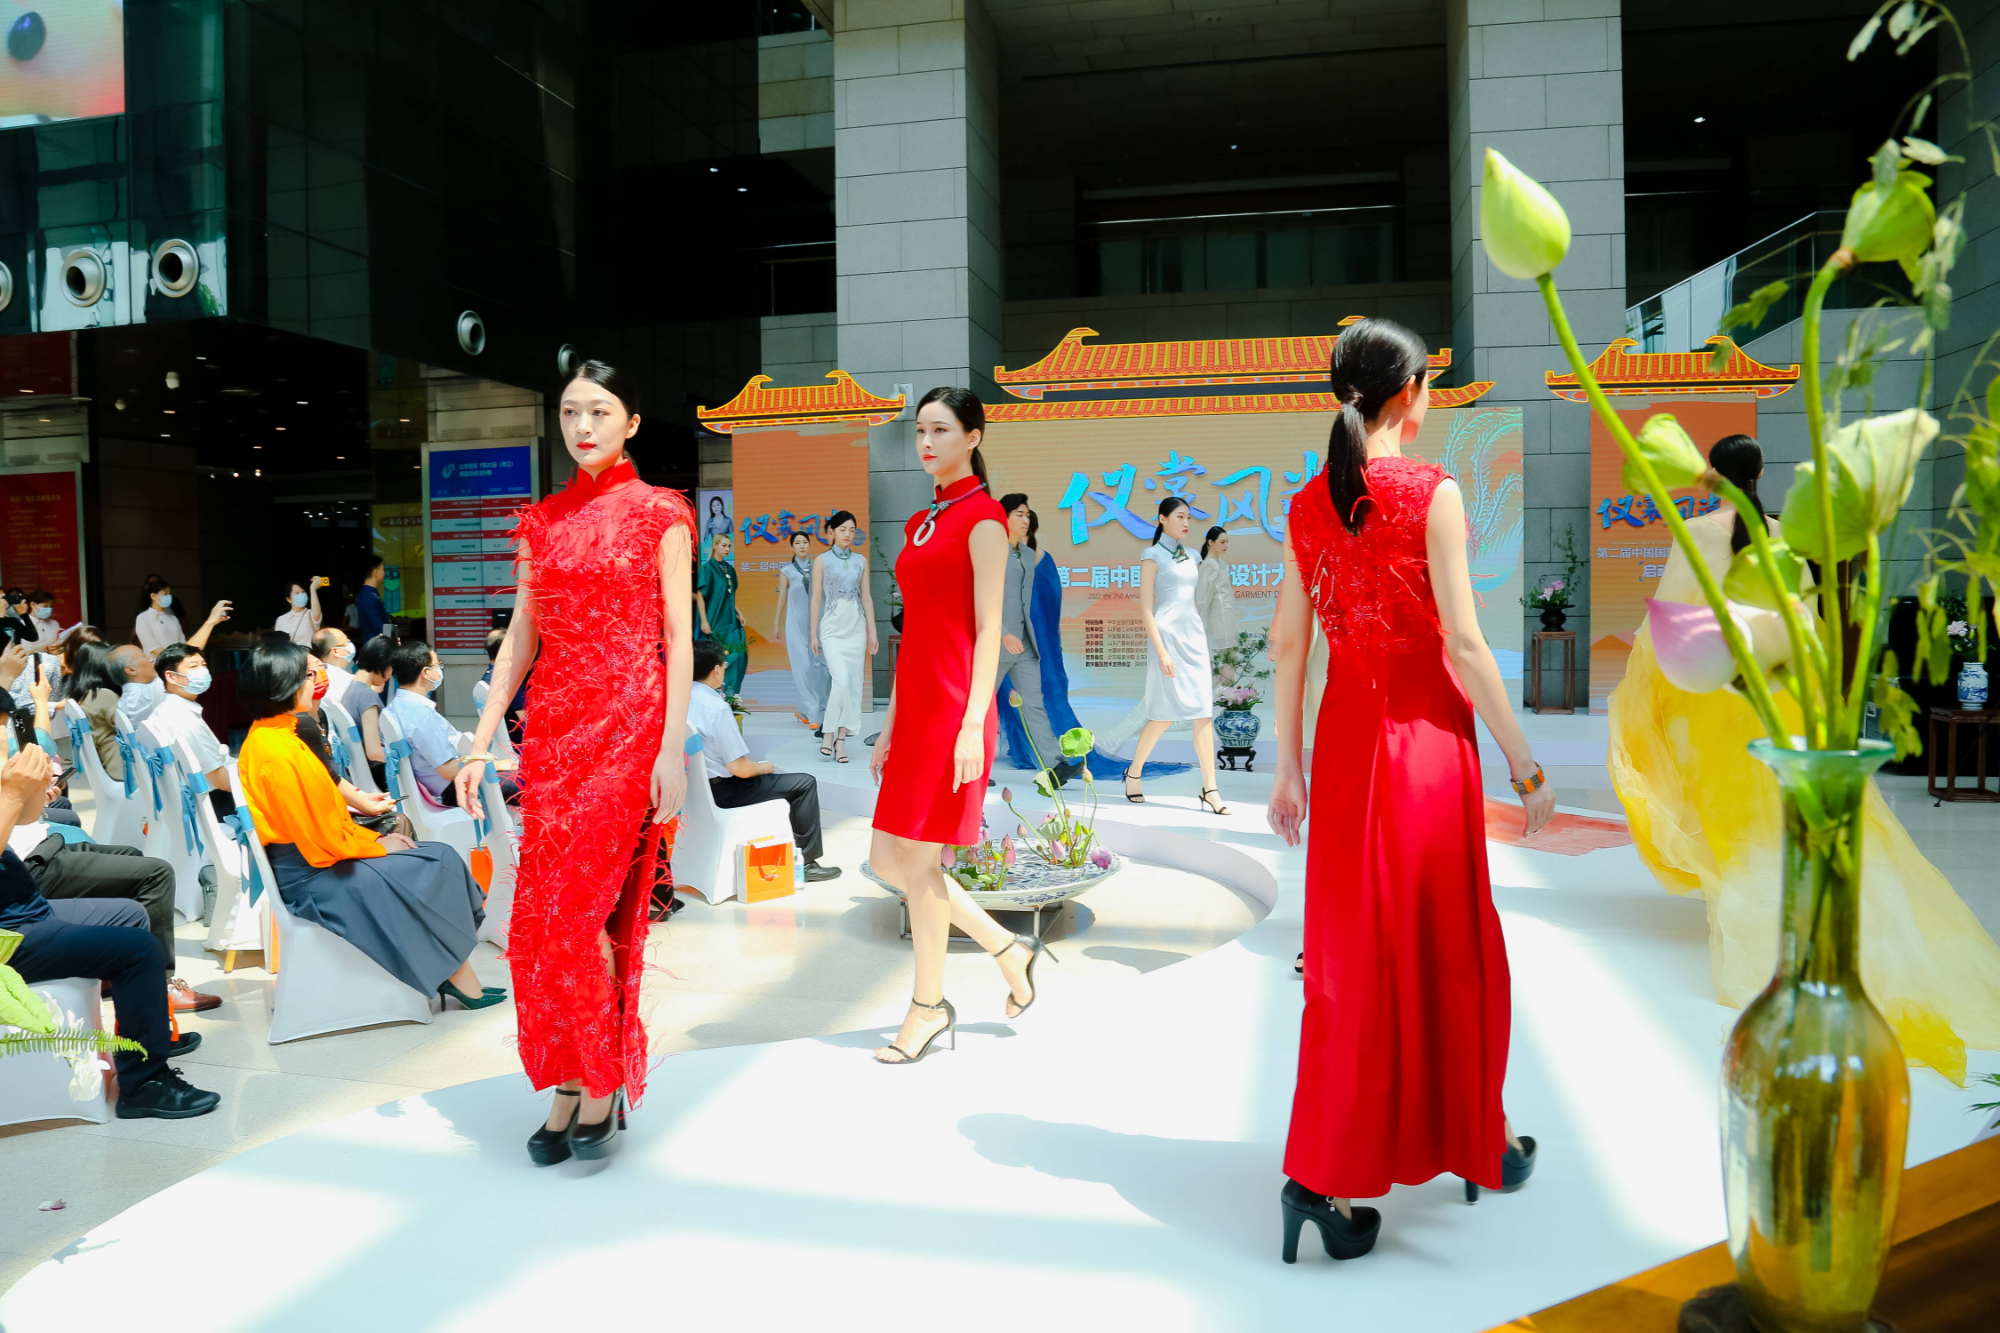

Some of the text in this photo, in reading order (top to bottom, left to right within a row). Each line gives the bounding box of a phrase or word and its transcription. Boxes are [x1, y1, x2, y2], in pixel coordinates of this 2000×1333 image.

[739, 508, 838, 546] 仪裳风
[740, 561, 794, 572] 第二届中国
[1226, 562, 1285, 587] 设计大
[1234, 590, 1272, 599] GARMENT
